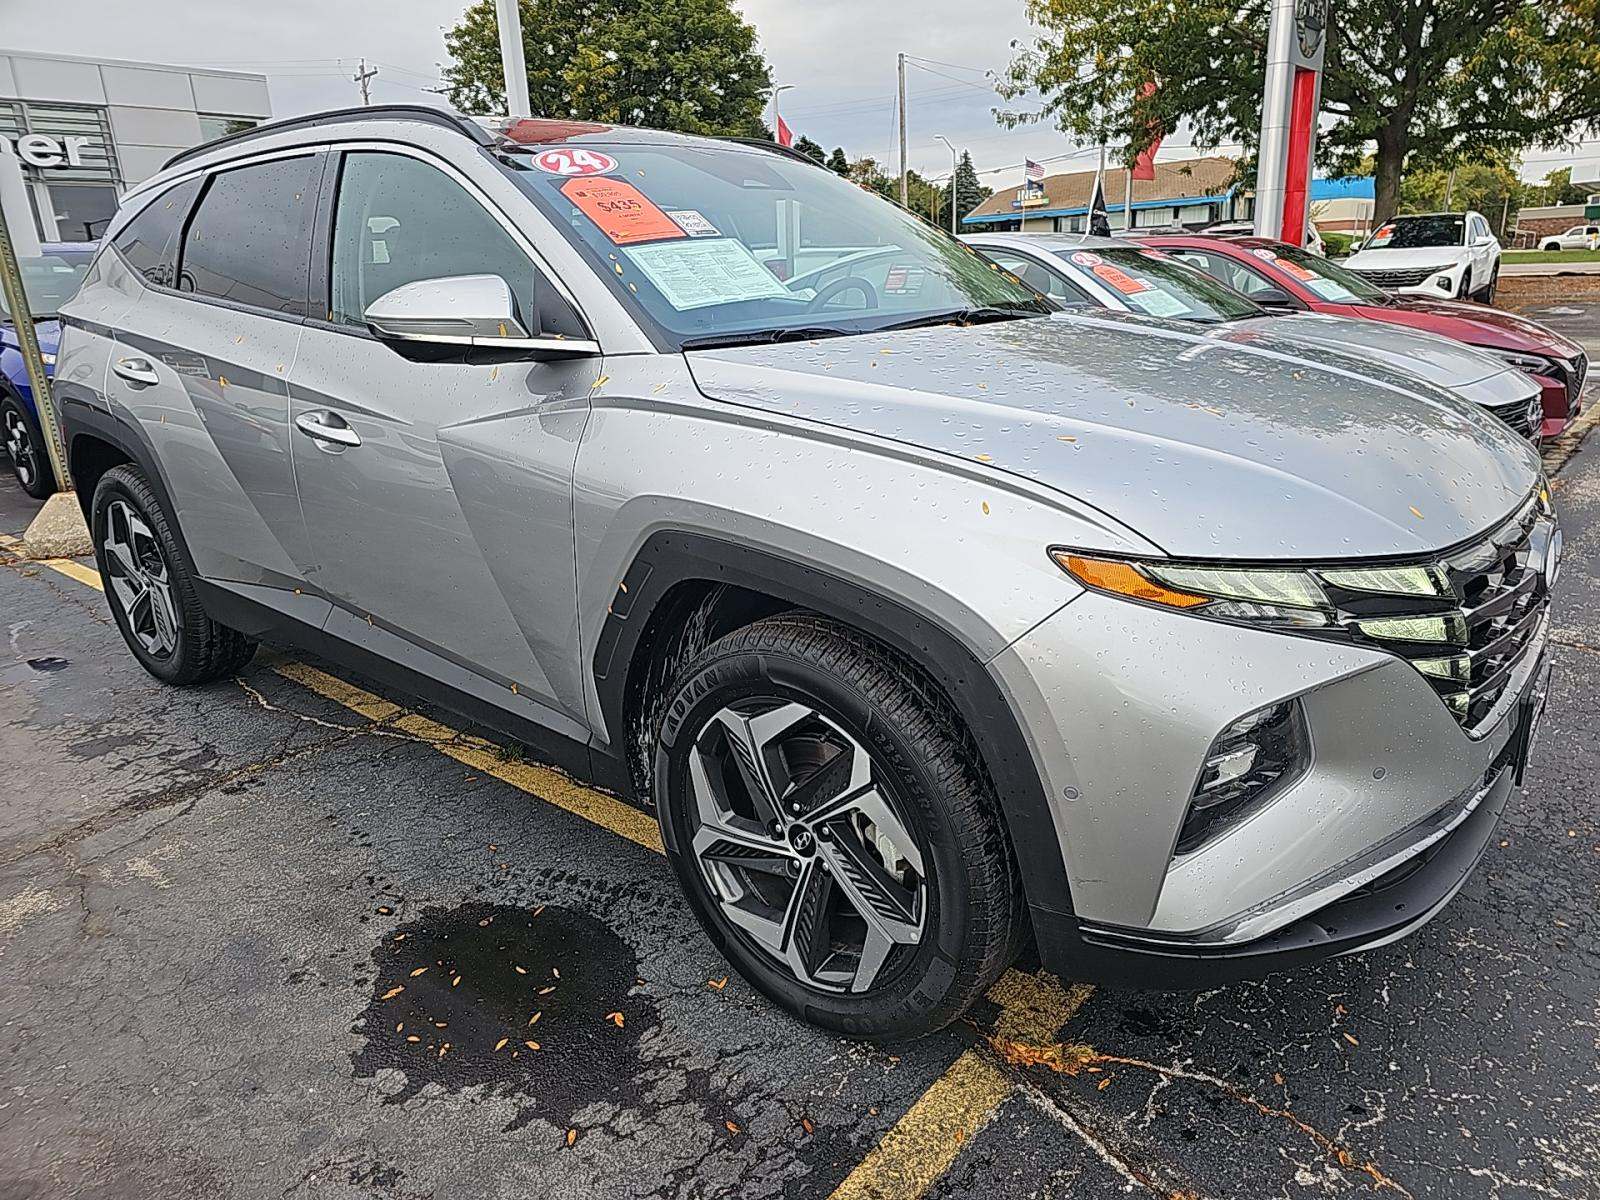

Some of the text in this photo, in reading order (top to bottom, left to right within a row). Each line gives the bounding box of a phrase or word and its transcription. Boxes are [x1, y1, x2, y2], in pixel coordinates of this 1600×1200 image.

[546, 150, 605, 173] 24
[597, 200, 641, 213] $435
[666, 665, 720, 737] ADVAN
